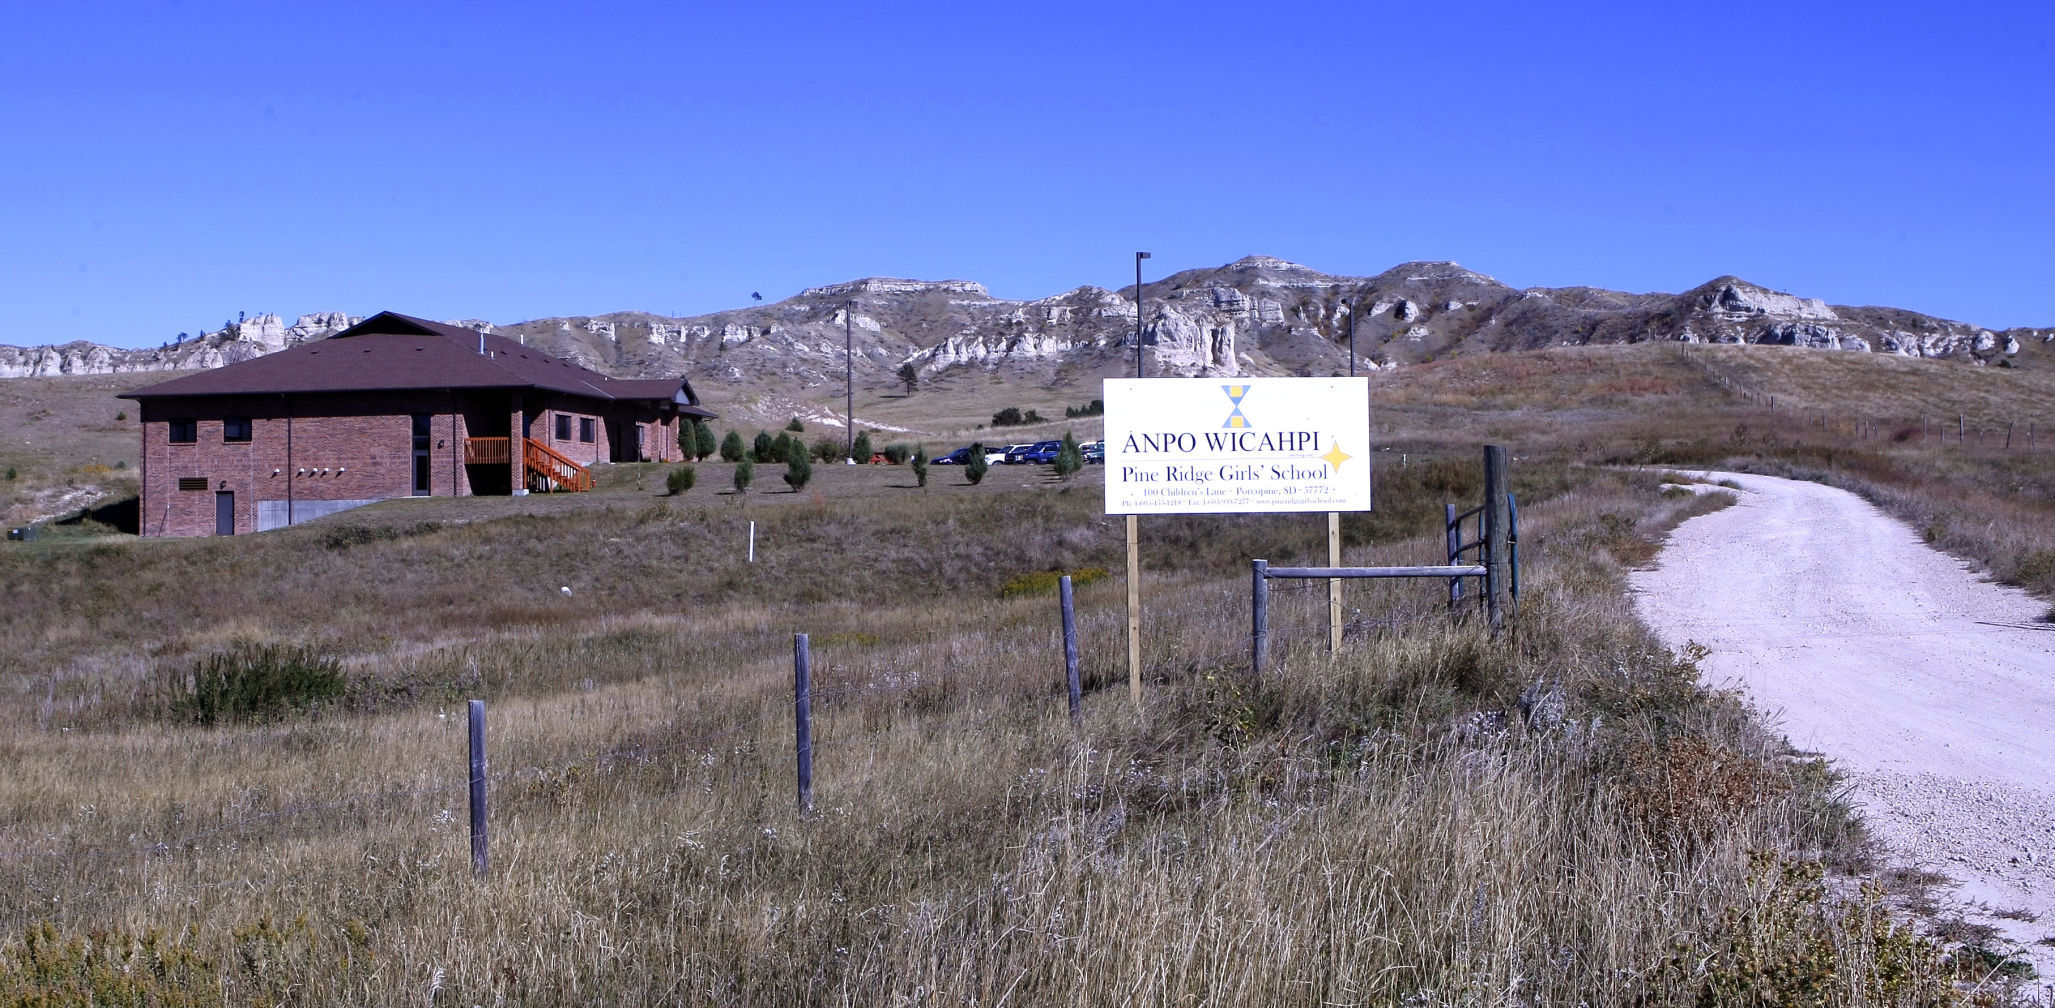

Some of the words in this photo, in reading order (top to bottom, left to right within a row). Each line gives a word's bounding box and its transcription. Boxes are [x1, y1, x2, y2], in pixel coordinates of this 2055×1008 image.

[1122, 432, 1197, 453] ANPO
[1206, 431, 1320, 453] WICAHPI
[1122, 466, 1160, 483] Pine
[1166, 465, 1213, 485] Ridge
[1219, 464, 1264, 481] Girls'
[1271, 463, 1328, 481] School
[1144, 488, 1159, 497] 100
[1161, 487, 1204, 497] Children's
[1206, 487, 1228, 496] Lane
[1236, 486, 1281, 498] Porcupine,
[1283, 486, 1297, 495] SD
[1303, 486, 1329, 495] 57772
